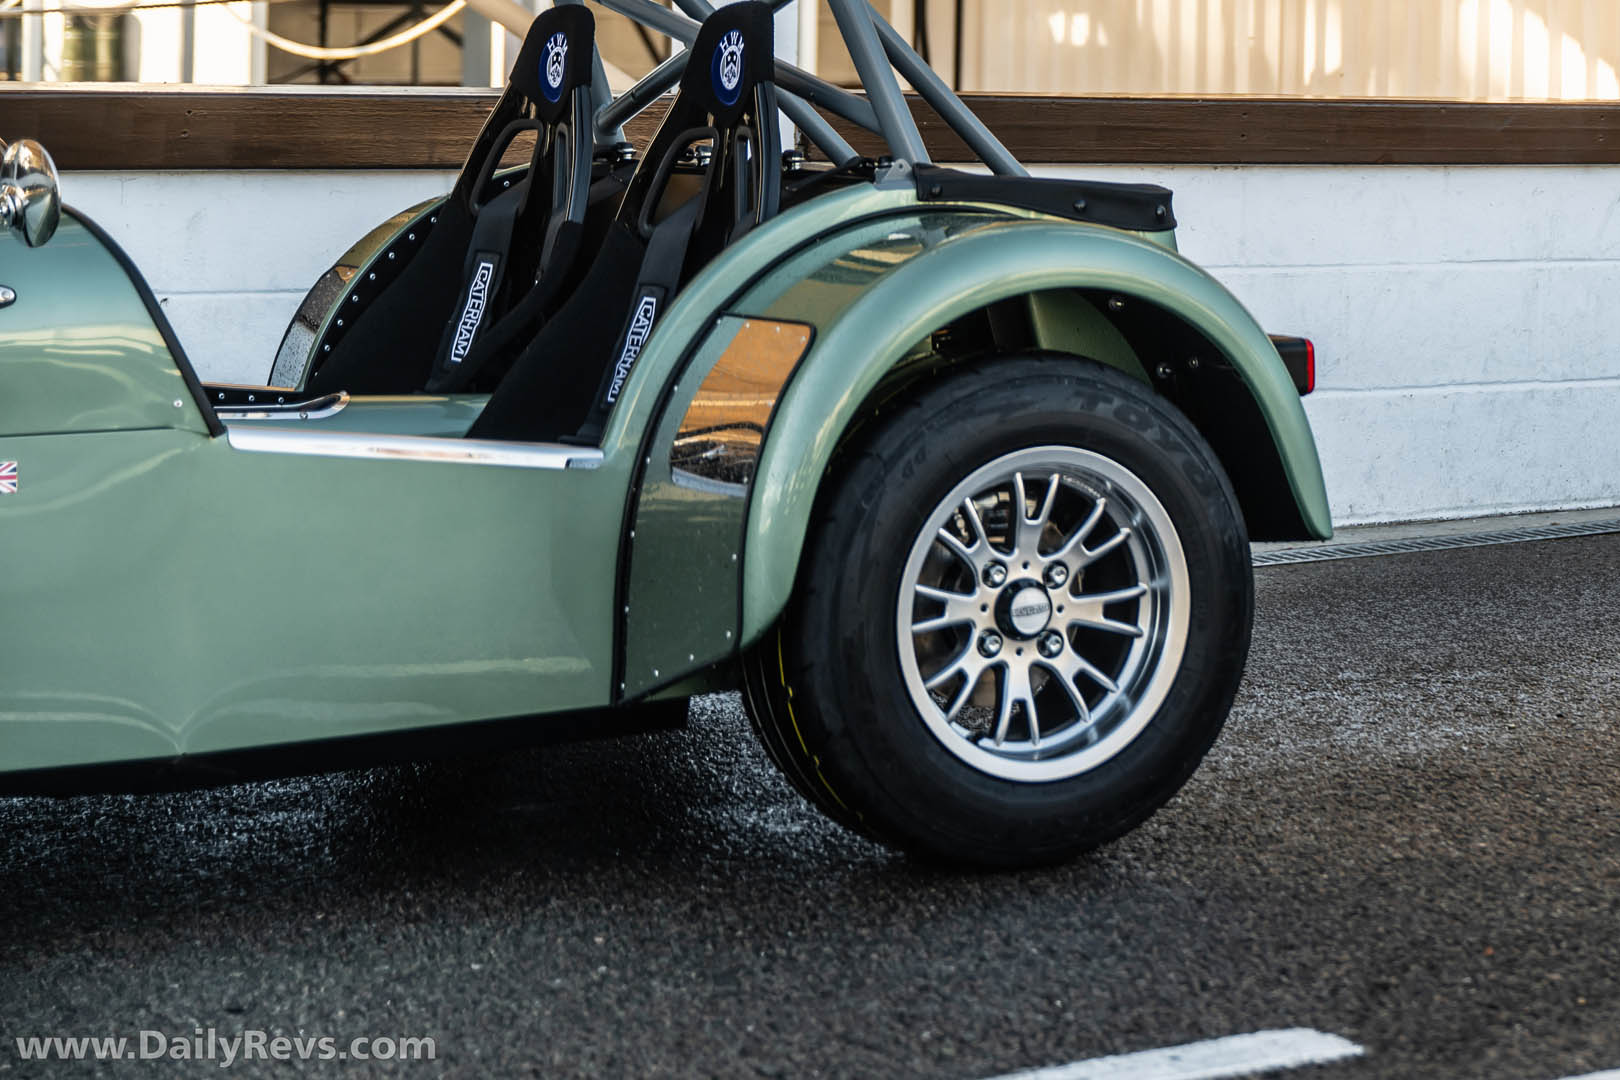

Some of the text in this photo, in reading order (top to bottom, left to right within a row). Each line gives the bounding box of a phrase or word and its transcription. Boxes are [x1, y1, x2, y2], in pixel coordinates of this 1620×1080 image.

[546, 33, 569, 55] HWM
[719, 31, 745, 55] HWM
[455, 269, 489, 355] CATERHAM
[610, 303, 653, 395] CATERHAM
